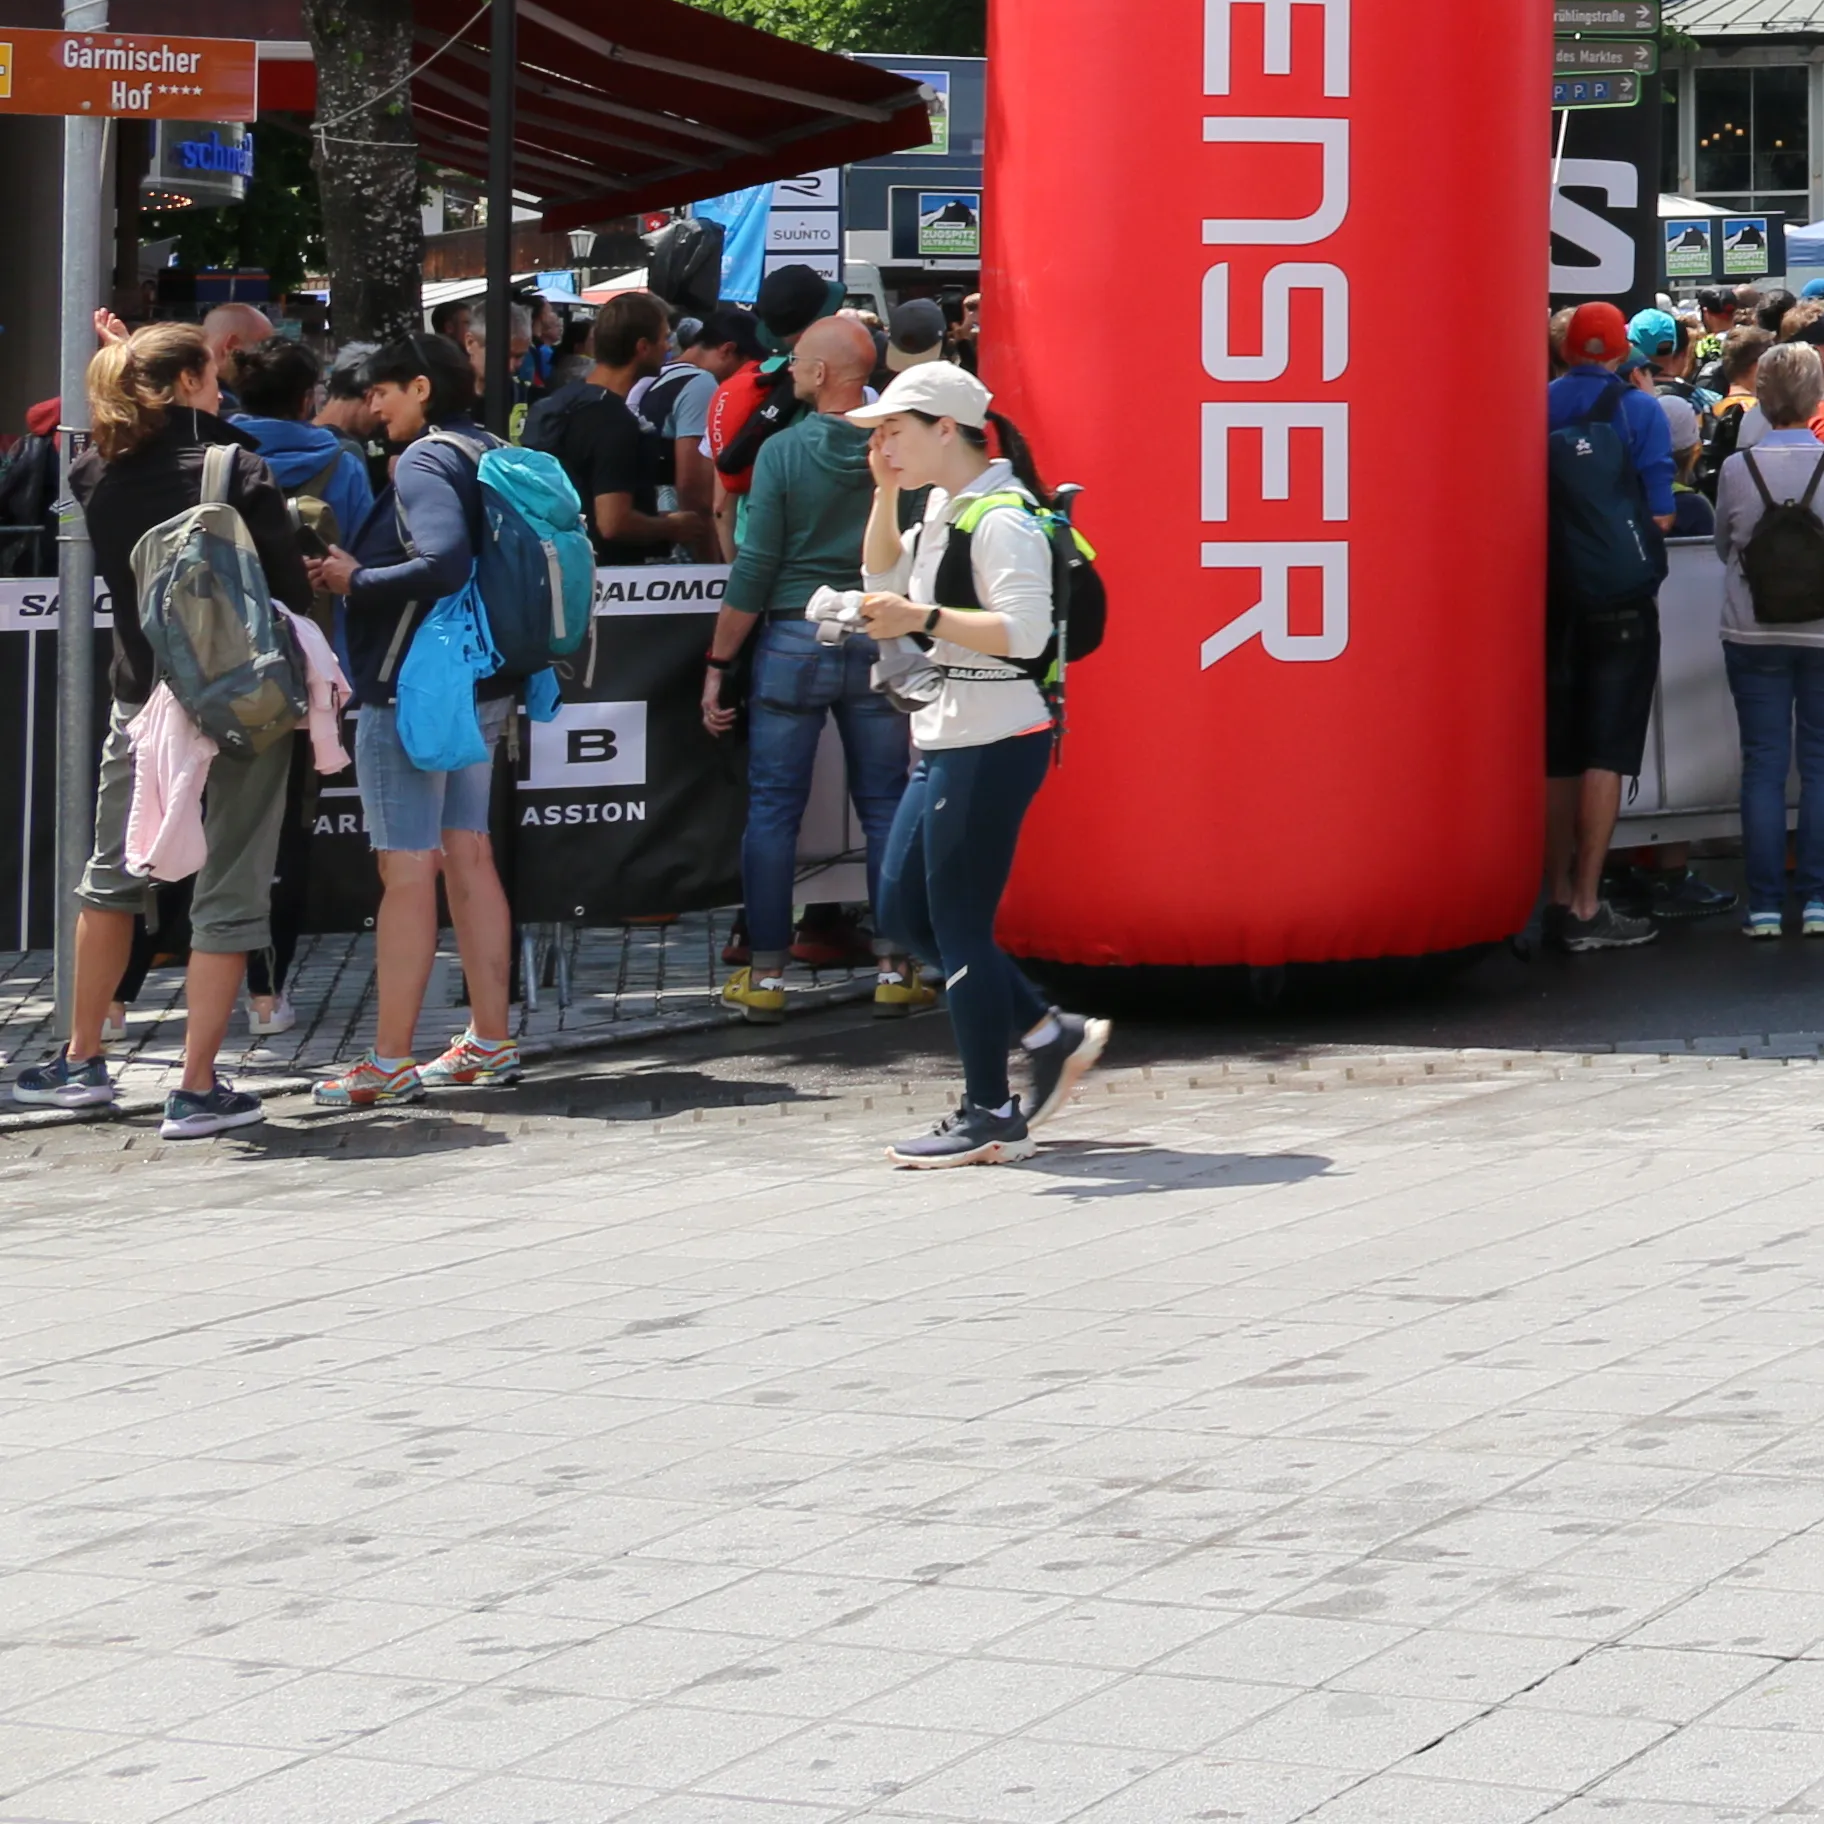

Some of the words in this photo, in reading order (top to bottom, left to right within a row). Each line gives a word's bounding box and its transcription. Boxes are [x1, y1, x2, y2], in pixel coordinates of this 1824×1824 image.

[1554, 9, 1625, 25] rühlingstraße
[63, 39, 201, 73] Garmischer
[1556, 49, 1575, 63] des
[111, 80, 152, 111] Hof
[773, 229, 831, 240] SUUNTO
[922, 230, 975, 239] ZUGSPITZ
[595, 579, 730, 603] SALOMO
[565, 728, 618, 764] B
[521, 801, 646, 827] ASSION
